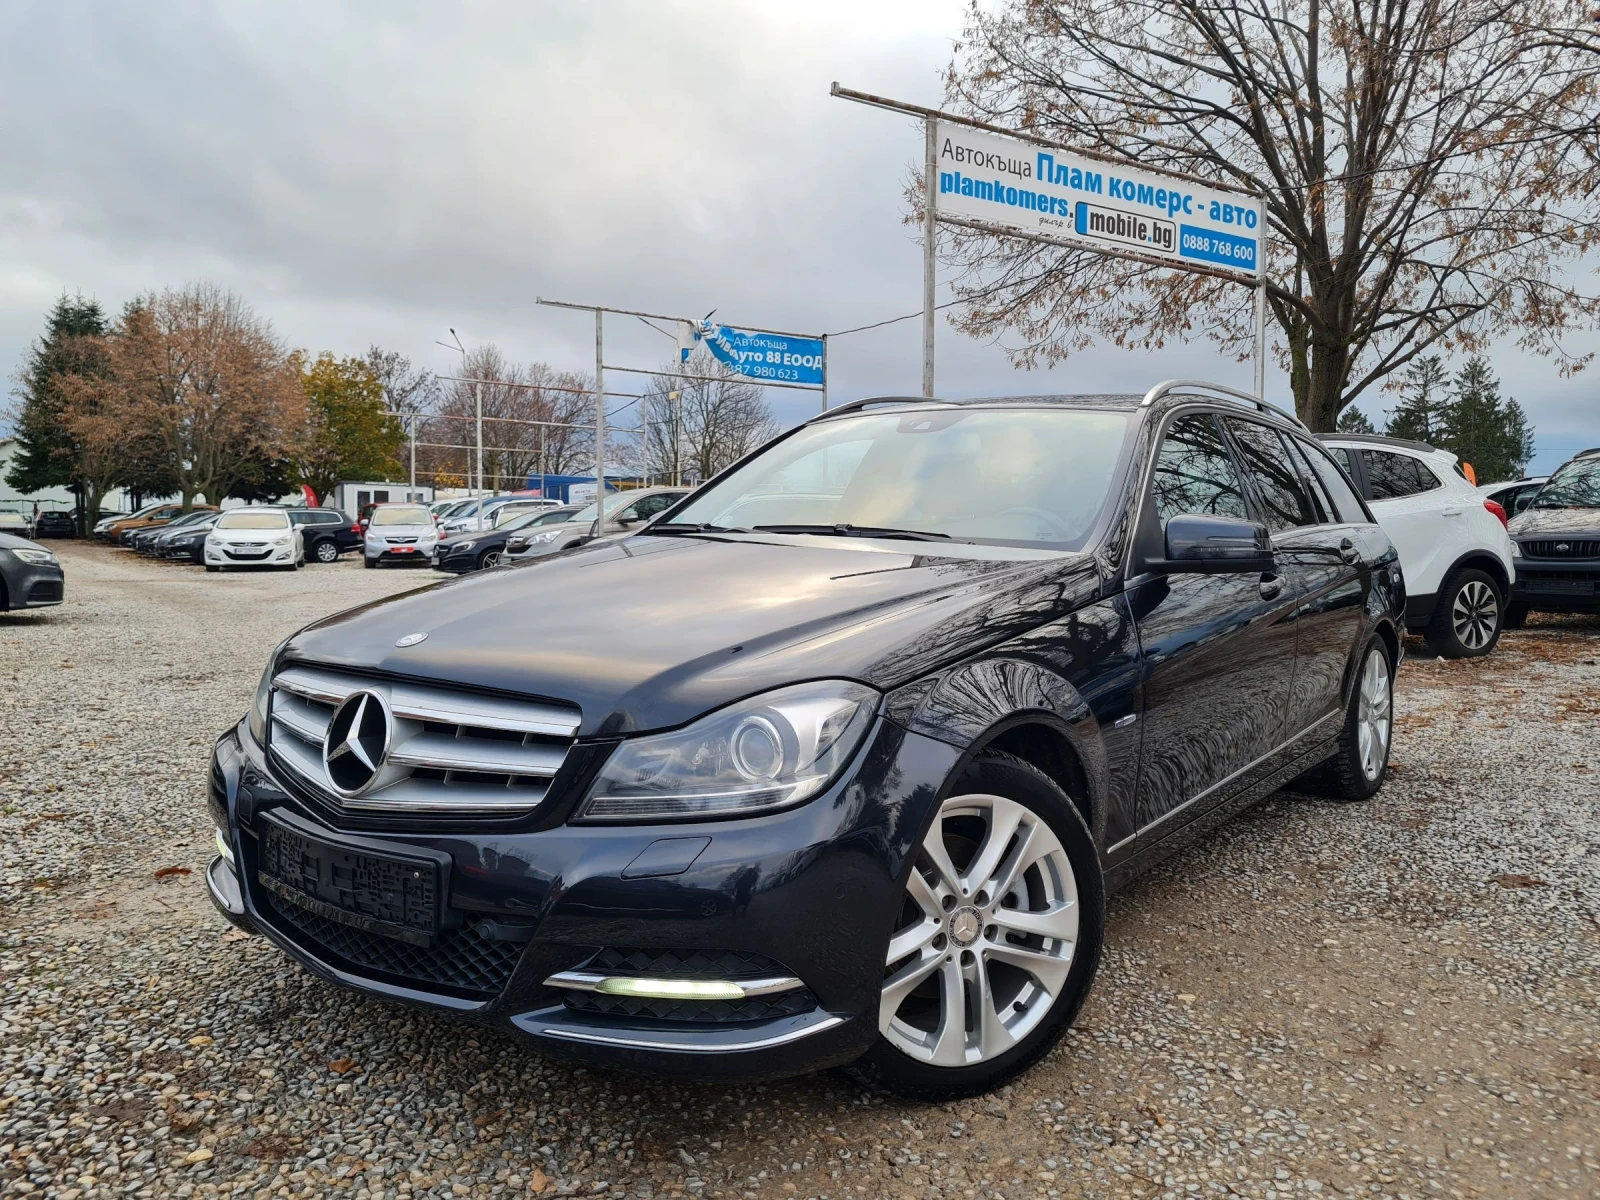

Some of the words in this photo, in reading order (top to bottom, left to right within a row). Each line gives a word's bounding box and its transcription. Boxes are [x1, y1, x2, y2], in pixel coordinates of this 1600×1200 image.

[941, 138, 1032, 180] Автокъща
[1037, 152, 1102, 194] Плам
[1109, 176, 1192, 218] комерс
[1209, 200, 1257, 229] авто
[1089, 211, 1172, 249] mobile.bg
[1183, 233, 1209, 252] 0888
[1212, 239, 1231, 257] 768
[1233, 244, 1253, 261] 600
[733, 336, 787, 350] Автокъща
[753, 366, 775, 377] 980
[777, 368, 799, 380] 623
[766, 351, 781, 364] 88
[783, 352, 822, 371] ЕООД
